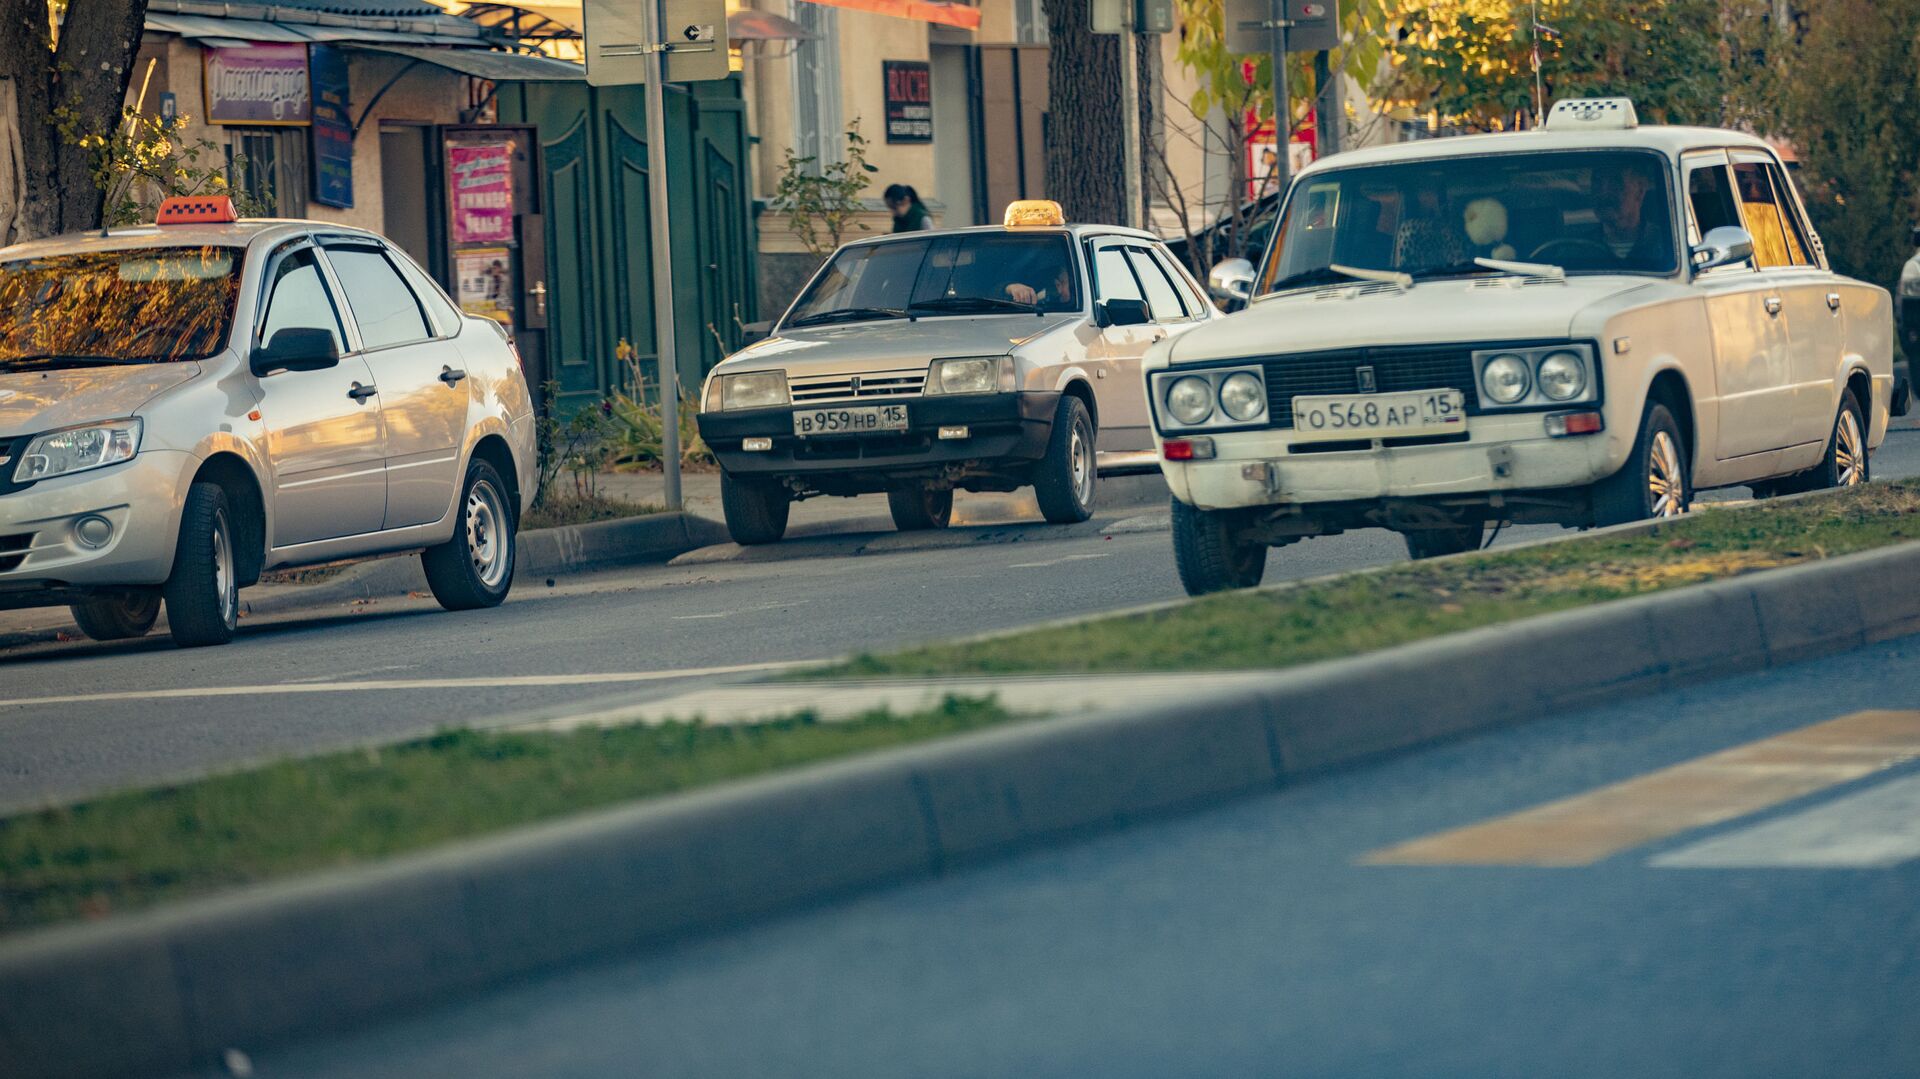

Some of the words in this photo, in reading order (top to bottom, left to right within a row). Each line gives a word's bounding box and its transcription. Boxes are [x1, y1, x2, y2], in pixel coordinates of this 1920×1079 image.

[888, 68, 929, 102] RICH
[883, 406, 900, 421] 15
[1425, 393, 1451, 416] 15
